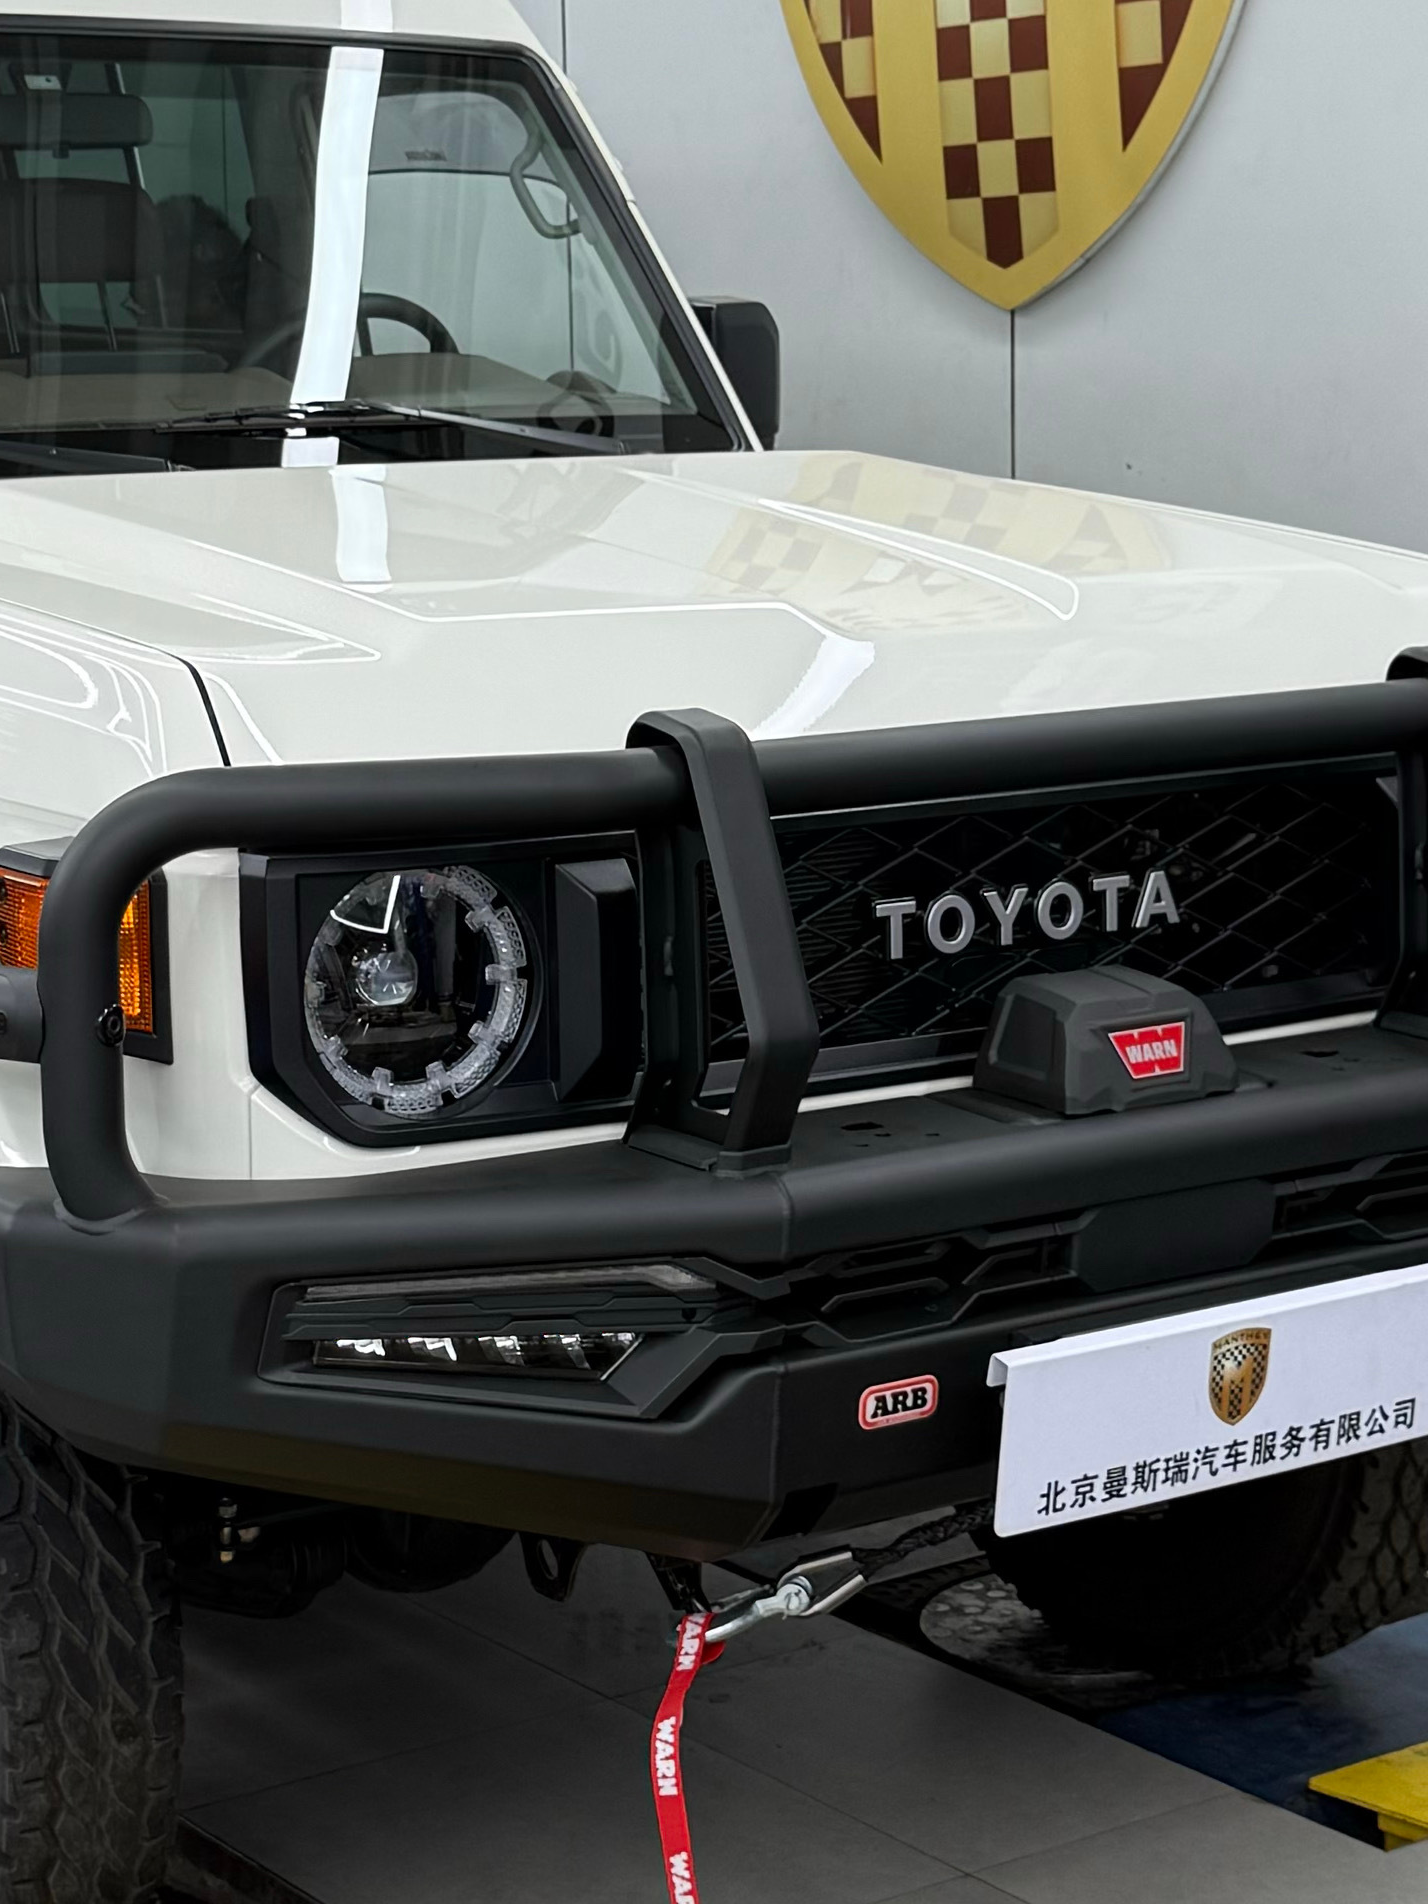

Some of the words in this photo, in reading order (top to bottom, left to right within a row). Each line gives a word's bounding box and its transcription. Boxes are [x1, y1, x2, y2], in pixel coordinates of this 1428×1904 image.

[874, 869, 1181, 960] TOYOTA
[1125, 1039, 1178, 1064] WARN
[870, 1386, 928, 1420] ARB
[1036, 1396, 1417, 1517] 北京曼斯瑞汽车服务有限公司
[654, 1716, 679, 1797] WARN
